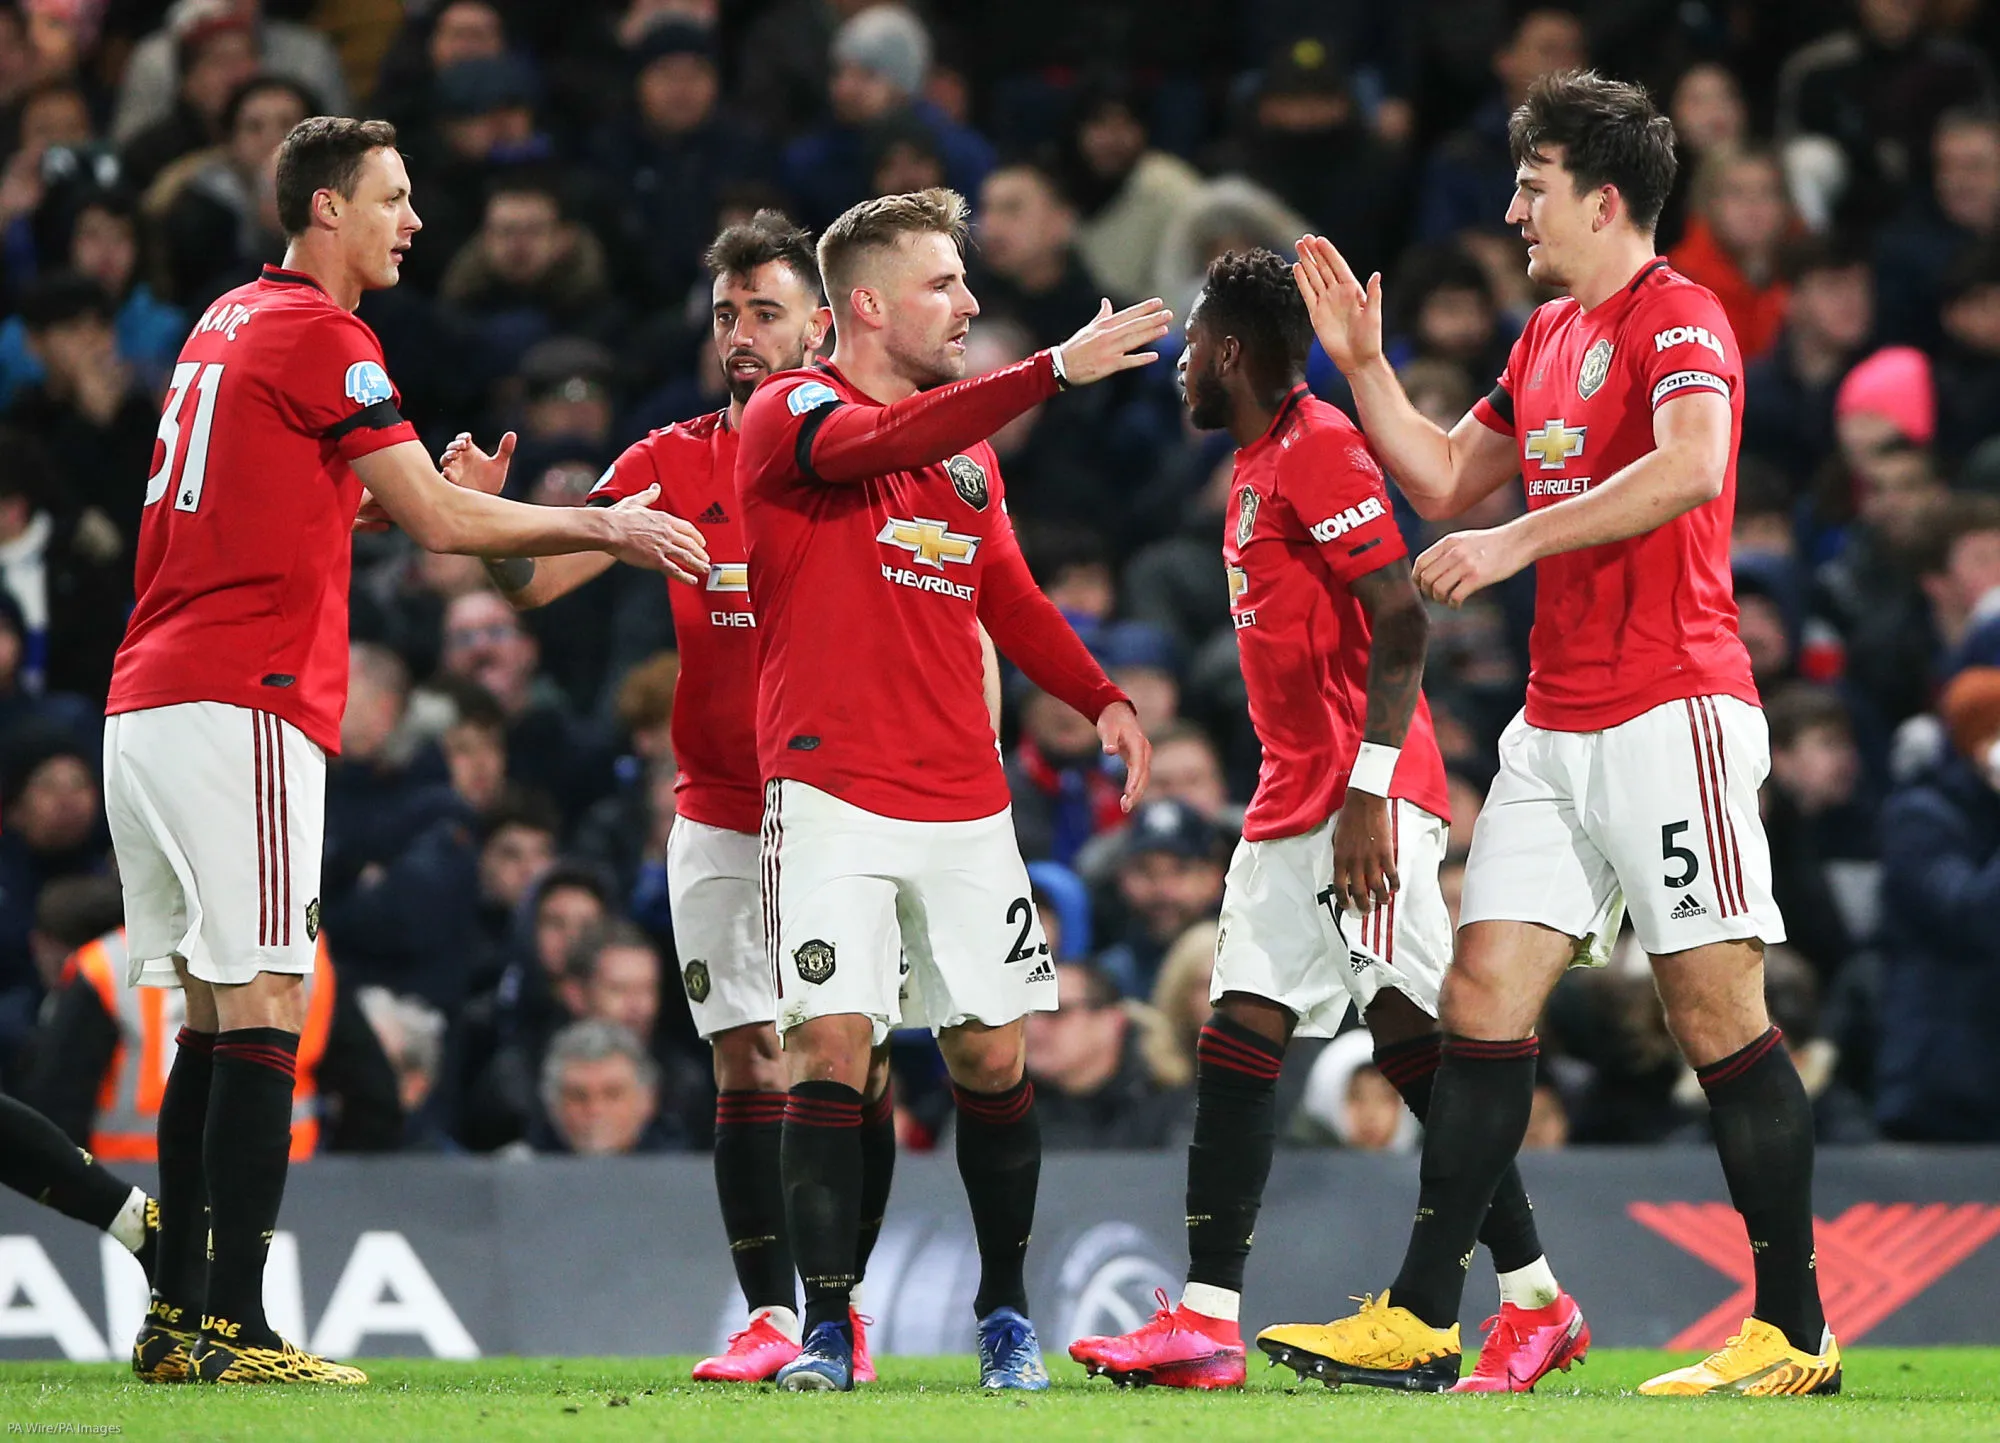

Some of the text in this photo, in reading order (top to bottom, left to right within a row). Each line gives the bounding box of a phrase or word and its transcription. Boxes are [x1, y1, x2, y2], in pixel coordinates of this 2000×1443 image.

[144, 362, 225, 513] 31
[1309, 496, 1387, 544] KOHLER
[1232, 609, 1257, 630] LET
[1661, 819, 1699, 888] 5
[1004, 897, 1049, 965] 2
[1670, 905, 1707, 920] adidas
[1025, 974, 1055, 984] adidas
